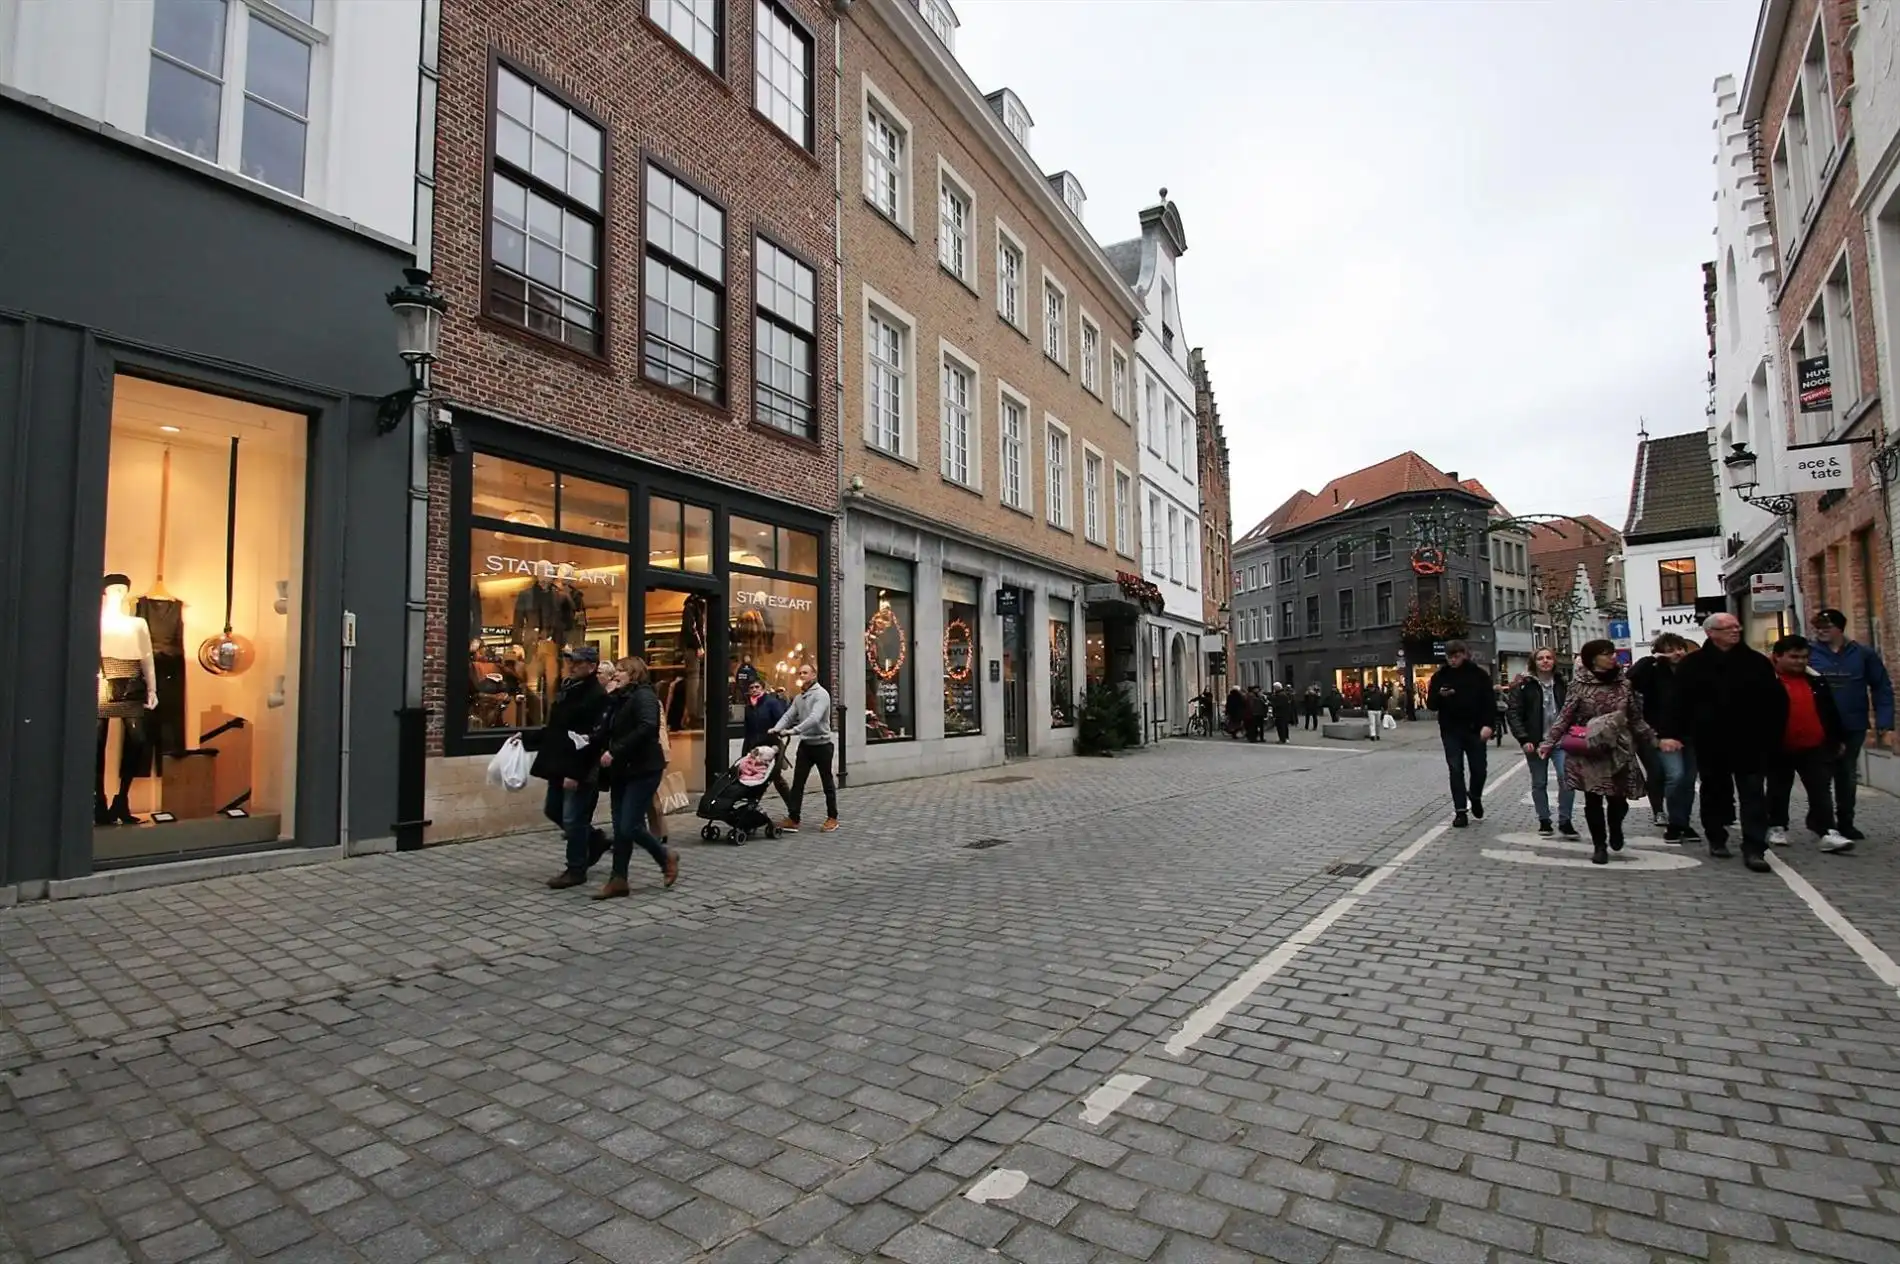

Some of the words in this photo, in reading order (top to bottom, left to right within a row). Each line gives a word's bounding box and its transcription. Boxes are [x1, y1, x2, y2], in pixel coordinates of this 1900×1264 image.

[1798, 459, 1825, 469] ace
[1829, 456, 1840, 466] &
[1811, 468, 1841, 479] tate
[486, 555, 559, 578] STATE
[578, 570, 619, 587] ART
[736, 590, 777, 607] STATE
[788, 599, 812, 611] ART
